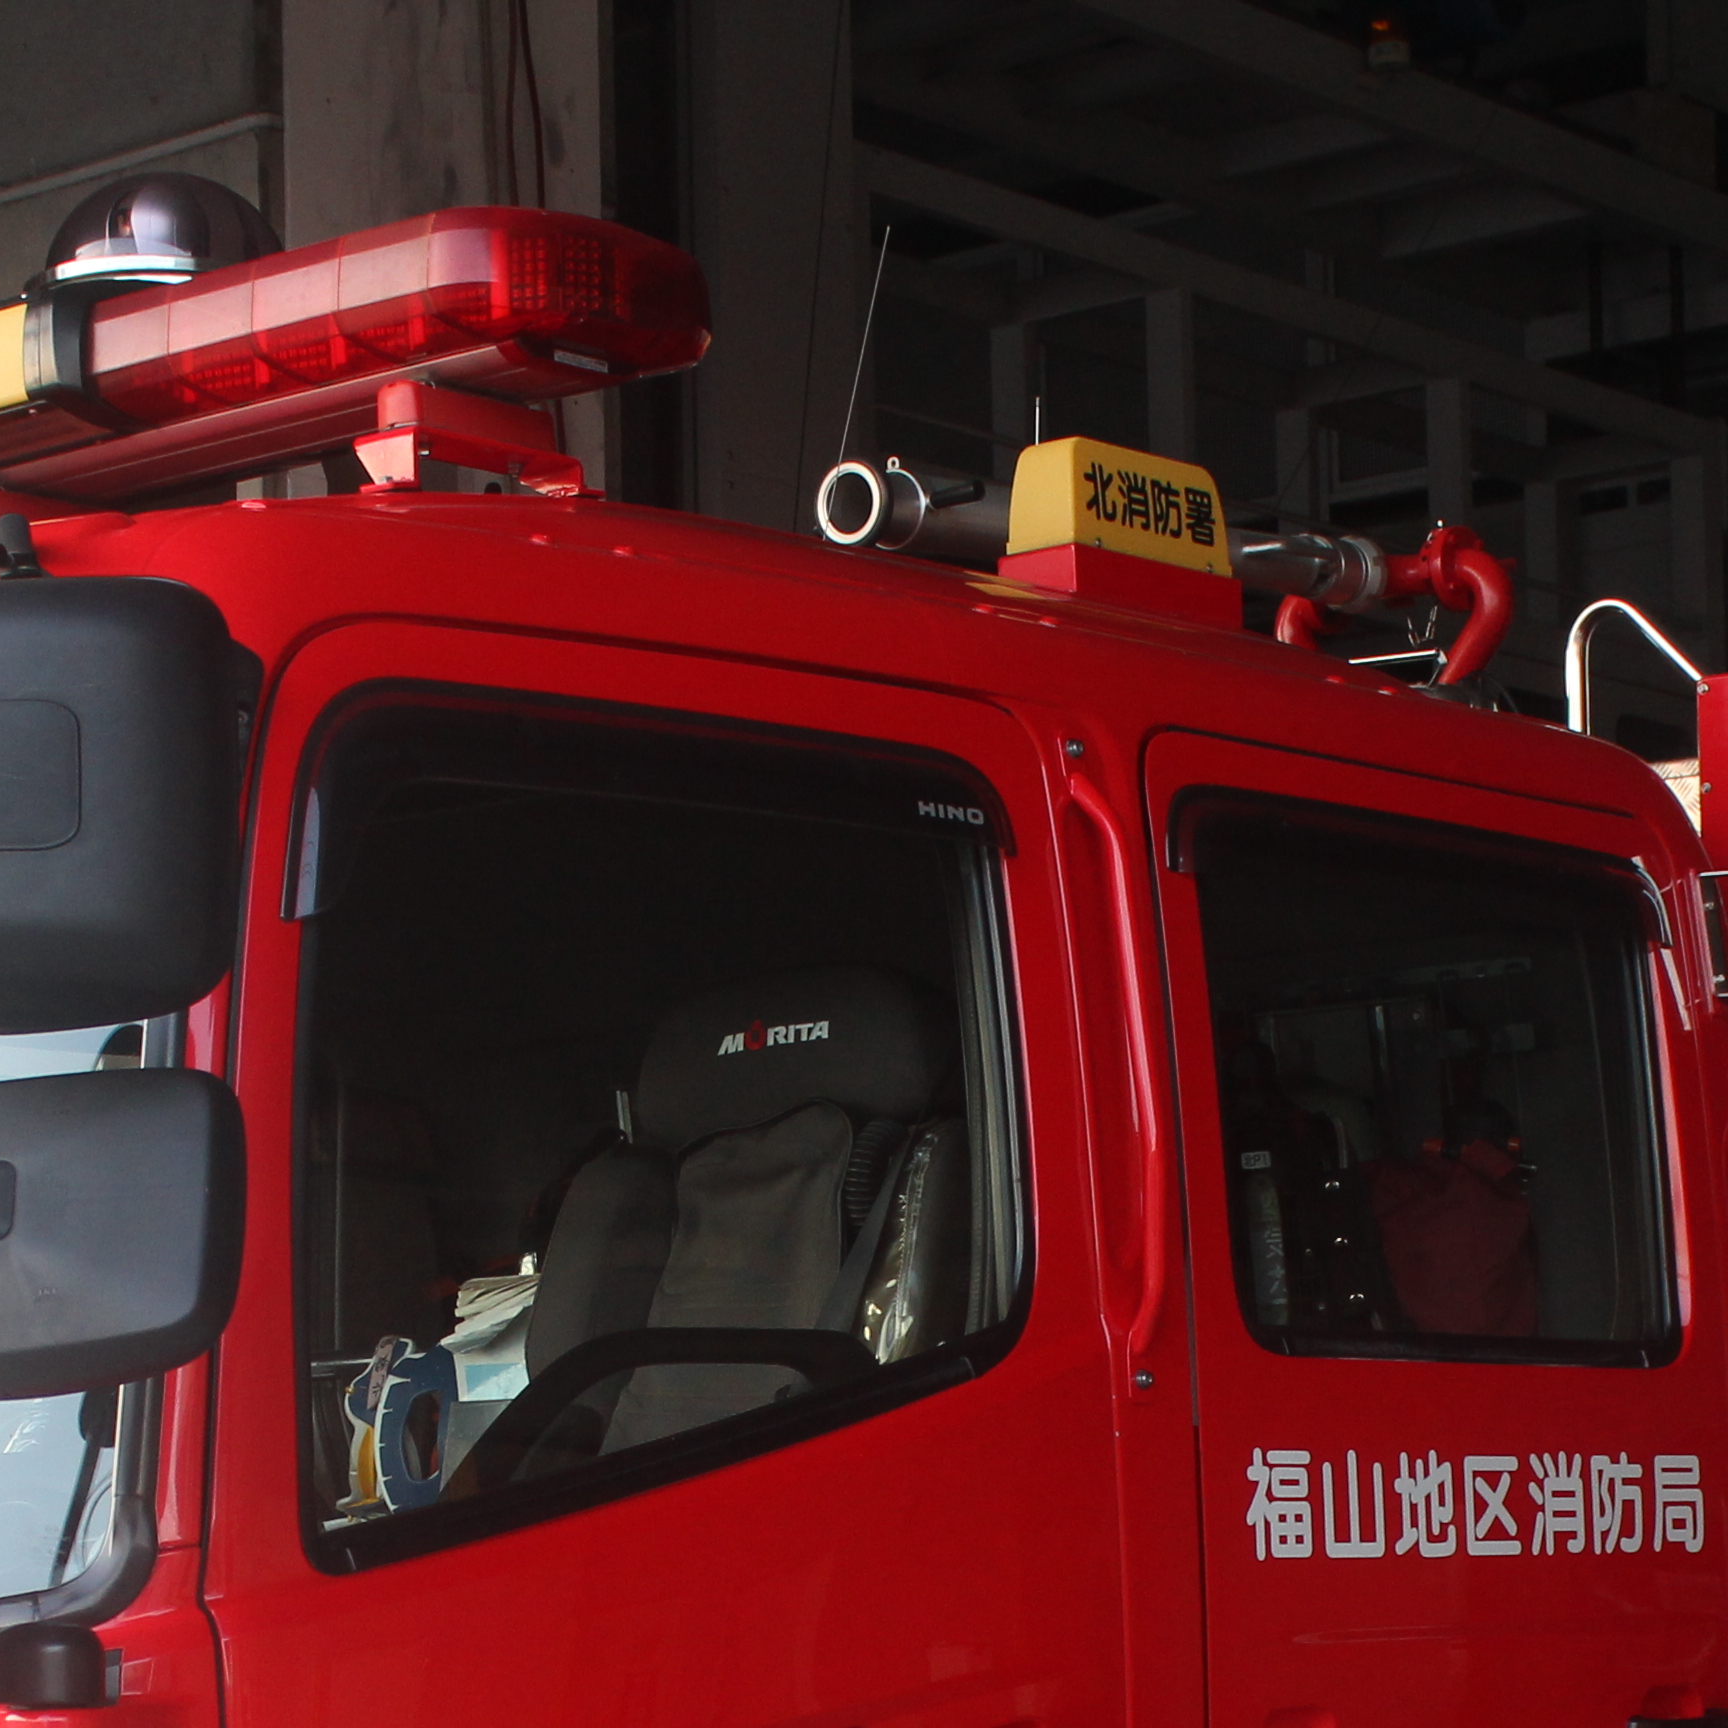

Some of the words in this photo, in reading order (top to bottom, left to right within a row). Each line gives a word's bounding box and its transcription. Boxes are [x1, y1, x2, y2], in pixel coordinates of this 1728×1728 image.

[1083, 461, 1216, 547] 北消防署
[917, 800, 985, 825] HINO
[717, 1019, 830, 1056] MORITA
[1246, 1447, 1705, 1562] 福山地区消防局
